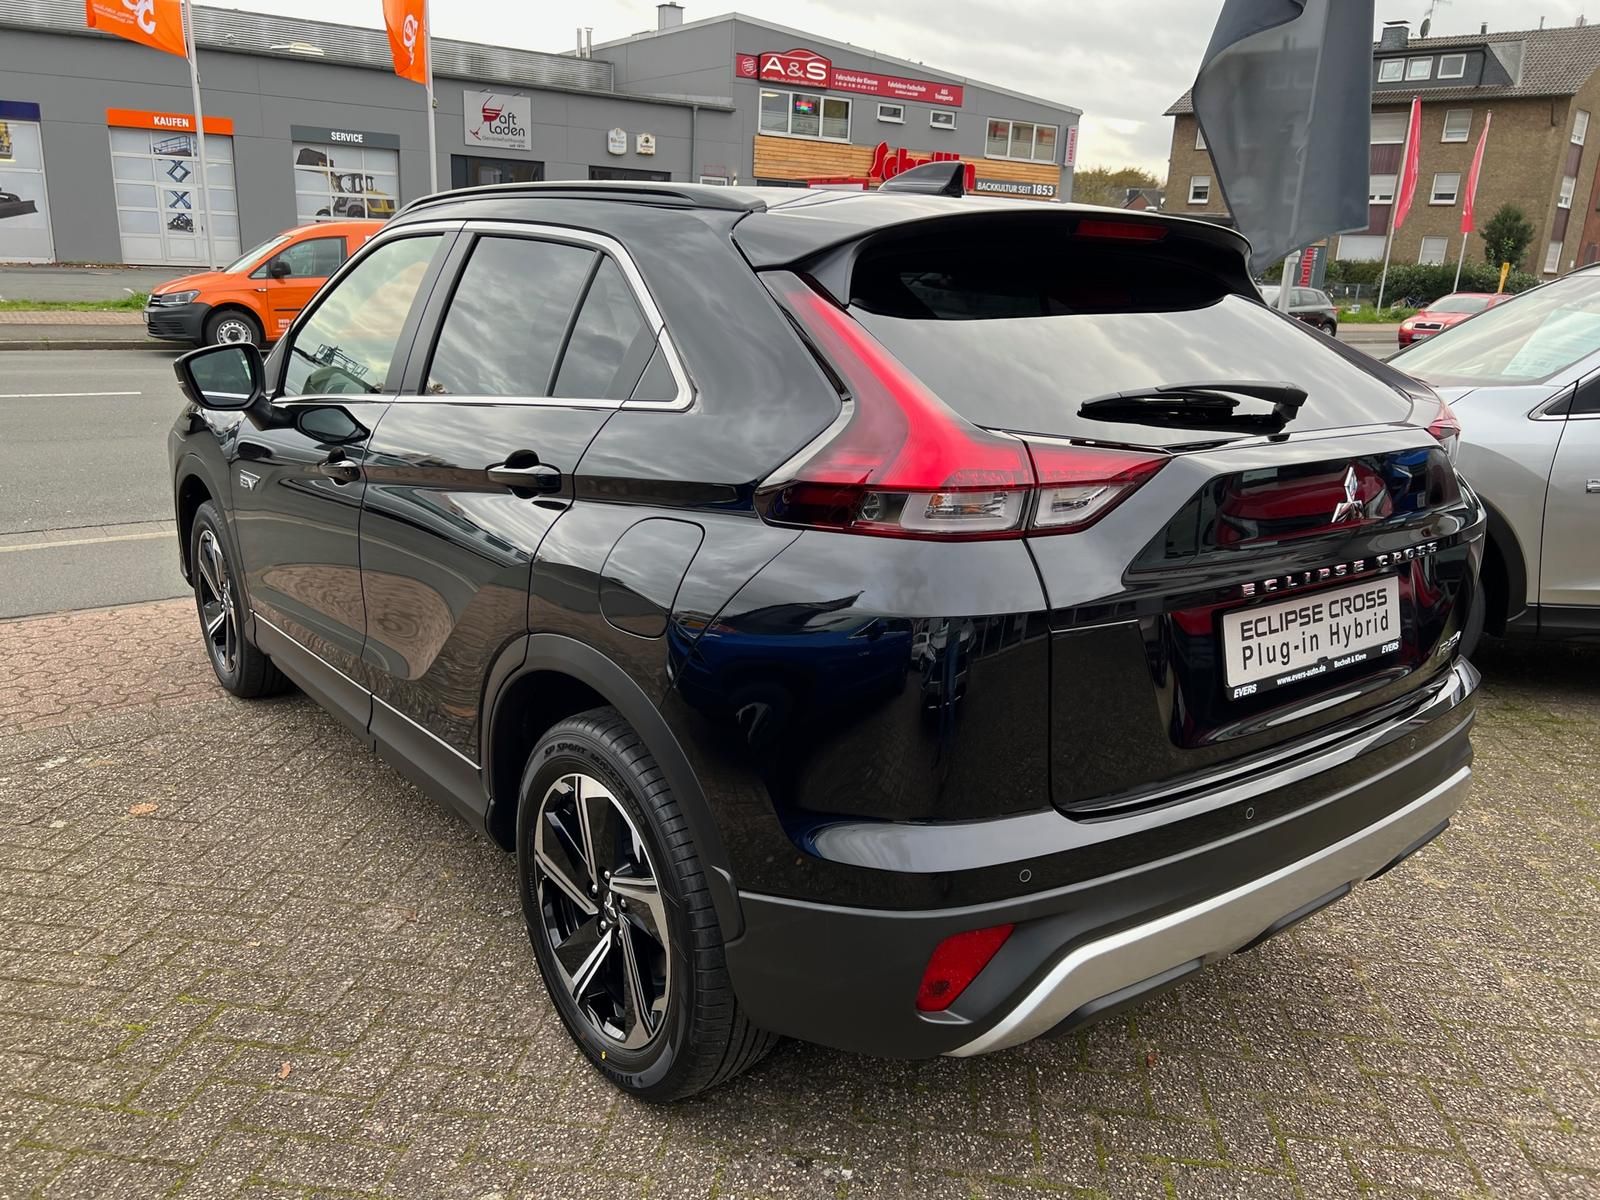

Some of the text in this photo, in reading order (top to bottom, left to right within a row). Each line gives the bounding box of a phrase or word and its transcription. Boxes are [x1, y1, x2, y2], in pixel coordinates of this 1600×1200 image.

[762, 56, 827, 81] A&S
[153, 115, 189, 128] KAUFEN
[330, 131, 363, 143] SERVICE
[977, 181, 1054, 196] BACKKULTUR SEIT 1853
[1241, 541, 1438, 598] ECLIPSE CROSS
[1240, 588, 1388, 642] ECLIPSE CROSS
[1242, 609, 1389, 670] Plug-in Hybrid
[1381, 641, 1400, 654] EVERS
[1276, 664, 1327, 686] www.evers-auto.de
[1233, 683, 1258, 699] EVERS
